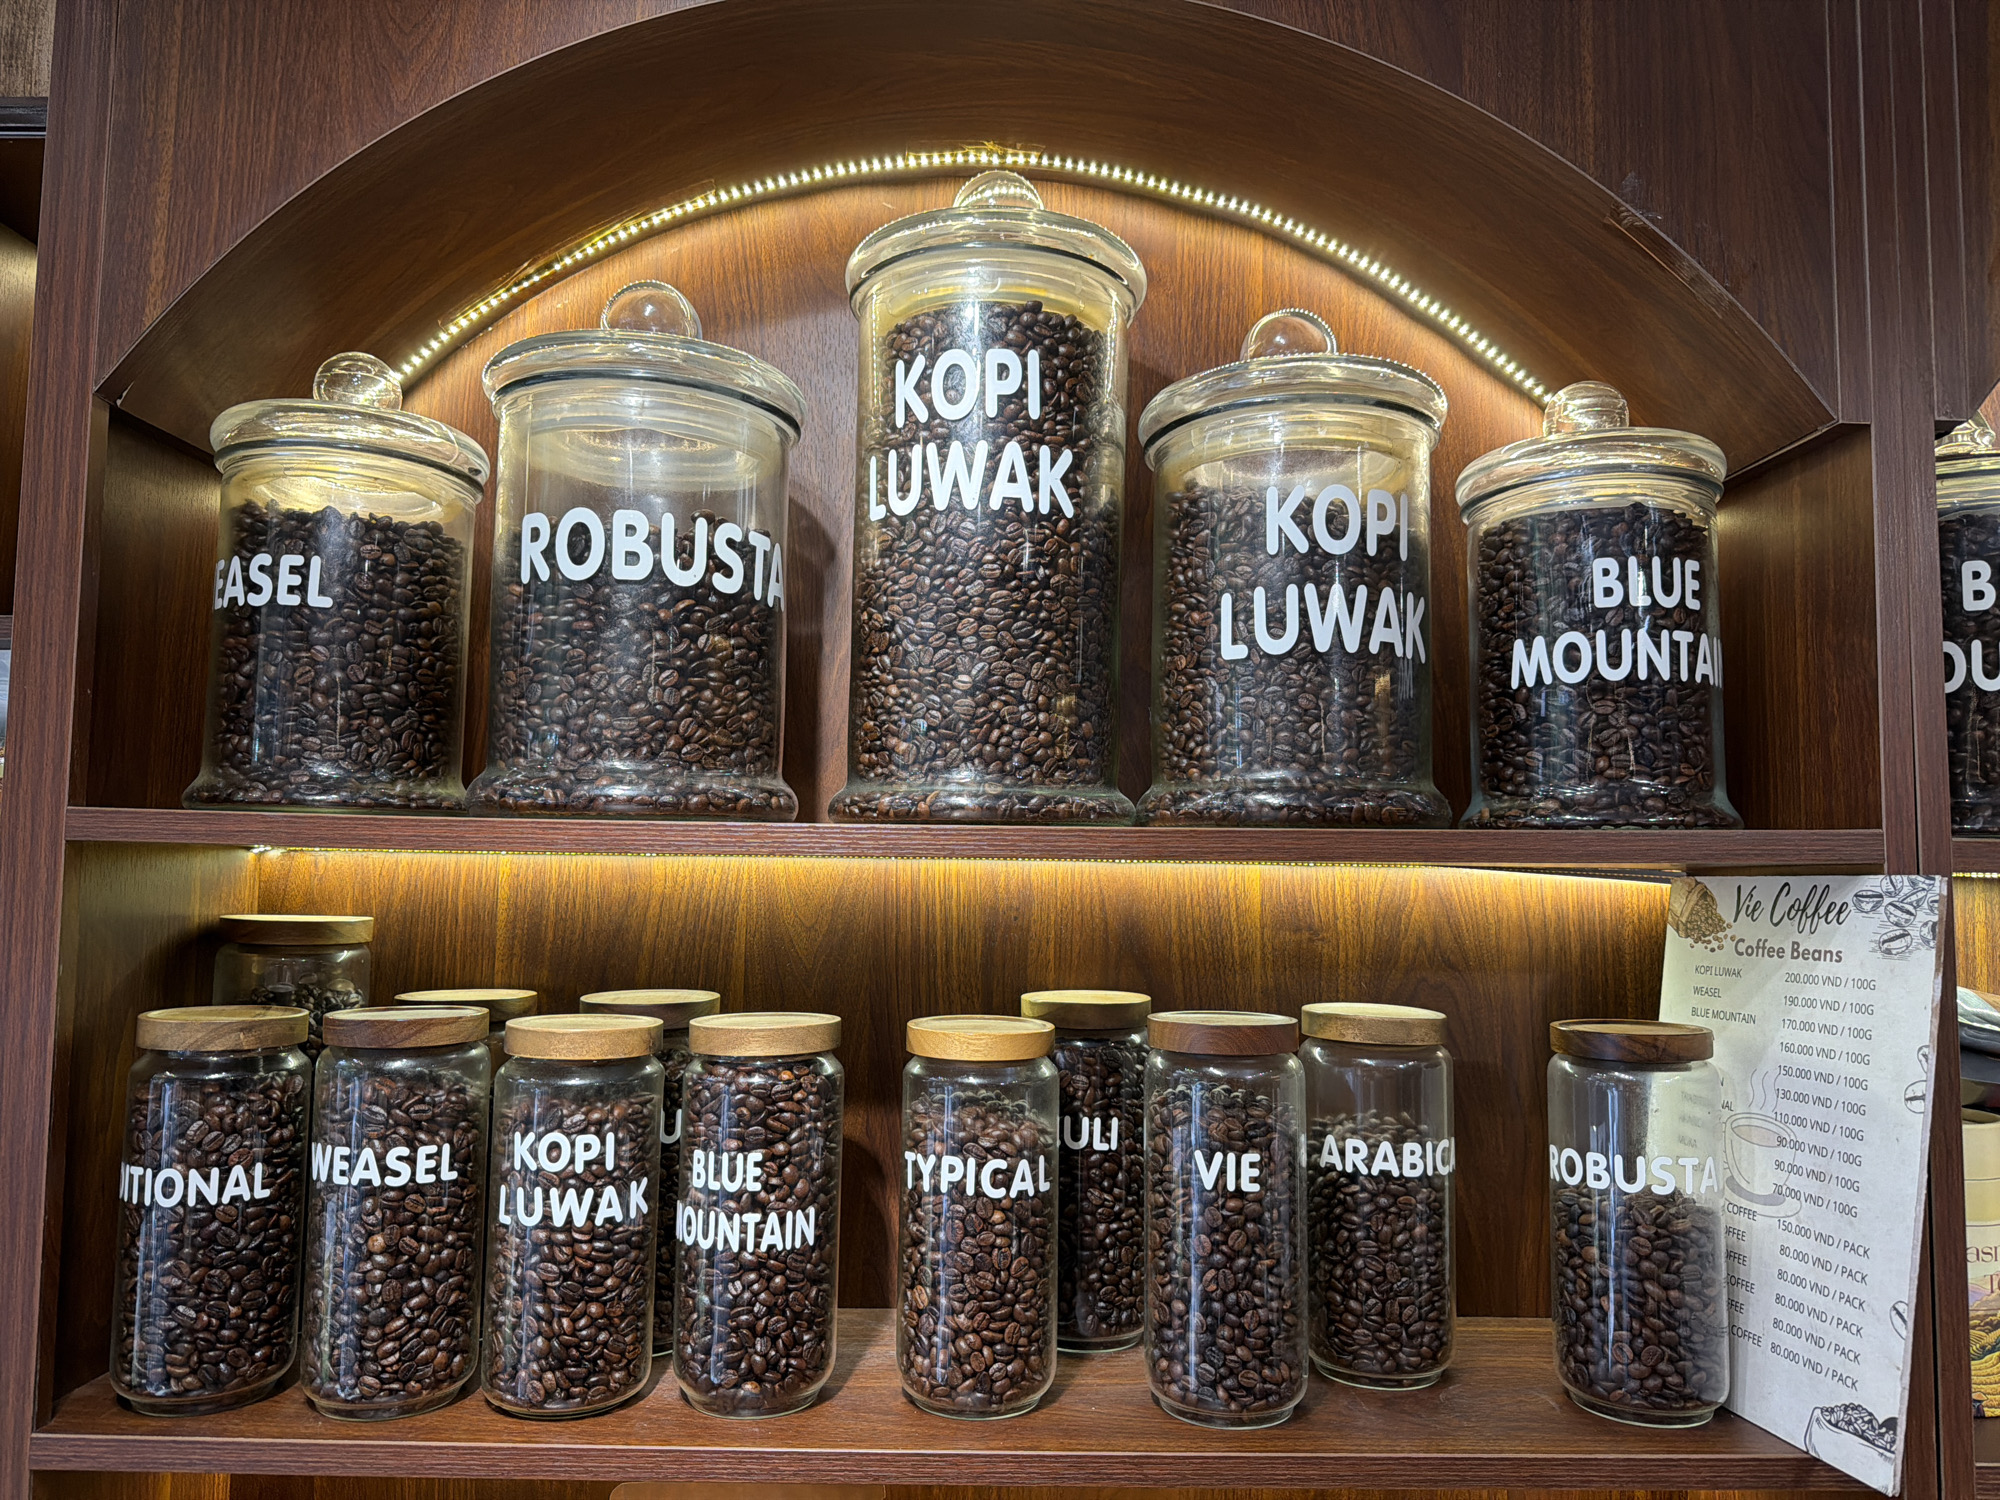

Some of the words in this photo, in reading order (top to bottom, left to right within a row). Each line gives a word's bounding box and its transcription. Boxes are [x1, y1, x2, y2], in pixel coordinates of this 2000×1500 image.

[895, 349, 1041, 429] KOPI
[869, 440, 1074, 522] LUWAK
[1265, 484, 1408, 562] KOPI
[520, 506, 785, 613] ROBUSTA
[1592, 556, 1701, 611] BLUE
[1220, 583, 1425, 664] LUWAK
[1511, 628, 1723, 689] MOUNTAI
[1733, 884, 1764, 923] Vie
[1769, 882, 1852, 935] Coffee
[1694, 964, 1713, 976] KOPI
[1714, 966, 1743, 979] LUWAK
[1734, 938, 1786, 959] Coffee
[1790, 941, 1843, 963] Beans
[1693, 986, 1722, 999] WEASEL
[1784, 972, 1820, 986] 200.000
[1821, 975, 1842, 988] VND
[1844, 977, 1850, 988] /
[1851, 978, 1876, 991] 100G
[1691, 1007, 1711, 1020] BLUE
[1711, 1010, 1757, 1025] MOUNTAIN
[1783, 995, 1818, 1010] 190.000
[1819, 999, 1841, 1012] VND
[1842, 1001, 1847, 1013] /
[1849, 1002, 1874, 1016] 100G
[1781, 1018, 1815, 1033] 170.000
[1817, 1022, 1839, 1036] VND
[1840, 1026, 1845, 1037] /
[1847, 1026, 1872, 1041] 100G
[1780, 1042, 1814, 1057] 160.000
[1815, 1046, 1837, 1060] VND
[1838, 1050, 1843, 1061] /
[1845, 1051, 1870, 1066] 100G
[1777, 1064, 1812, 1081] 150.000
[1813, 1070, 1835, 1085] VND
[1836, 1075, 1841, 1086] /
[1843, 1076, 1868, 1091] 100G
[1776, 1088, 1810, 1105] 130.000
[1811, 1094, 1833, 1109] VND
[1834, 1100, 1839, 1110] /
[1841, 1100, 1866, 1116] 100G
[1774, 1111, 1808, 1129] 110.000
[1809, 1119, 1831, 1134] VND
[1832, 1124, 1837, 1135] /
[1839, 1125, 1864, 1142] 100G
[311, 1142, 458, 1187] WEASEL
[514, 1132, 615, 1174] KOPI
[692, 1149, 763, 1193] BLUE
[1194, 1150, 1262, 1193] VIE
[1549, 1144, 1720, 1196] ROBUSTA
[1776, 1135, 1806, 1153] 90.000
[1807, 1143, 1828, 1158] VND
[1830, 1149, 1835, 1160] /
[1837, 1150, 1862, 1167] 100G
[904, 1151, 1051, 1199] TYPICAL
[1774, 1159, 1804, 1177] 90.000
[1805, 1167, 1827, 1183] VND
[1828, 1173, 1833, 1184] /
[1835, 1175, 1860, 1193] 100G
[499, 1177, 649, 1228] LUWAK
[1726, 1202, 1758, 1222] COFFEE
[1772, 1182, 1802, 1201] 70.000
[1803, 1191, 1824, 1208] VND
[1825, 1199, 1831, 1210] /
[1833, 1200, 1858, 1218] 100G
[1777, 1218, 1812, 1240] 150.000
[1813, 1229, 1835, 1247] VND
[1836, 1238, 1842, 1249] /
[1843, 1240, 1870, 1260] PACK
[1779, 1244, 1810, 1265] 80.000
[1811, 1254, 1832, 1272] VND
[1834, 1263, 1840, 1275] /
[1841, 1265, 1868, 1286] PACK
[1777, 1268, 1808, 1290] 80.000
[1808, 1280, 1830, 1298] VND
[1831, 1289, 1837, 1301] /
[1838, 1291, 1866, 1313] PACK
[1731, 1324, 1763, 1348] COFFEE
[1774, 1292, 1805, 1315] 80.000
[1806, 1305, 1828, 1323] VND
[1829, 1315, 1835, 1327] /
[1836, 1317, 1864, 1339] PACK
[1772, 1317, 1803, 1340] 80.000
[1804, 1330, 1826, 1349] VND
[1826, 1341, 1832, 1352] /
[1833, 1343, 1861, 1366] PACK
[1770, 1341, 1800, 1365] 80.000
[1801, 1355, 1823, 1375] VND
[1824, 1367, 1830, 1378] /
[1831, 1369, 1859, 1392] PACK
